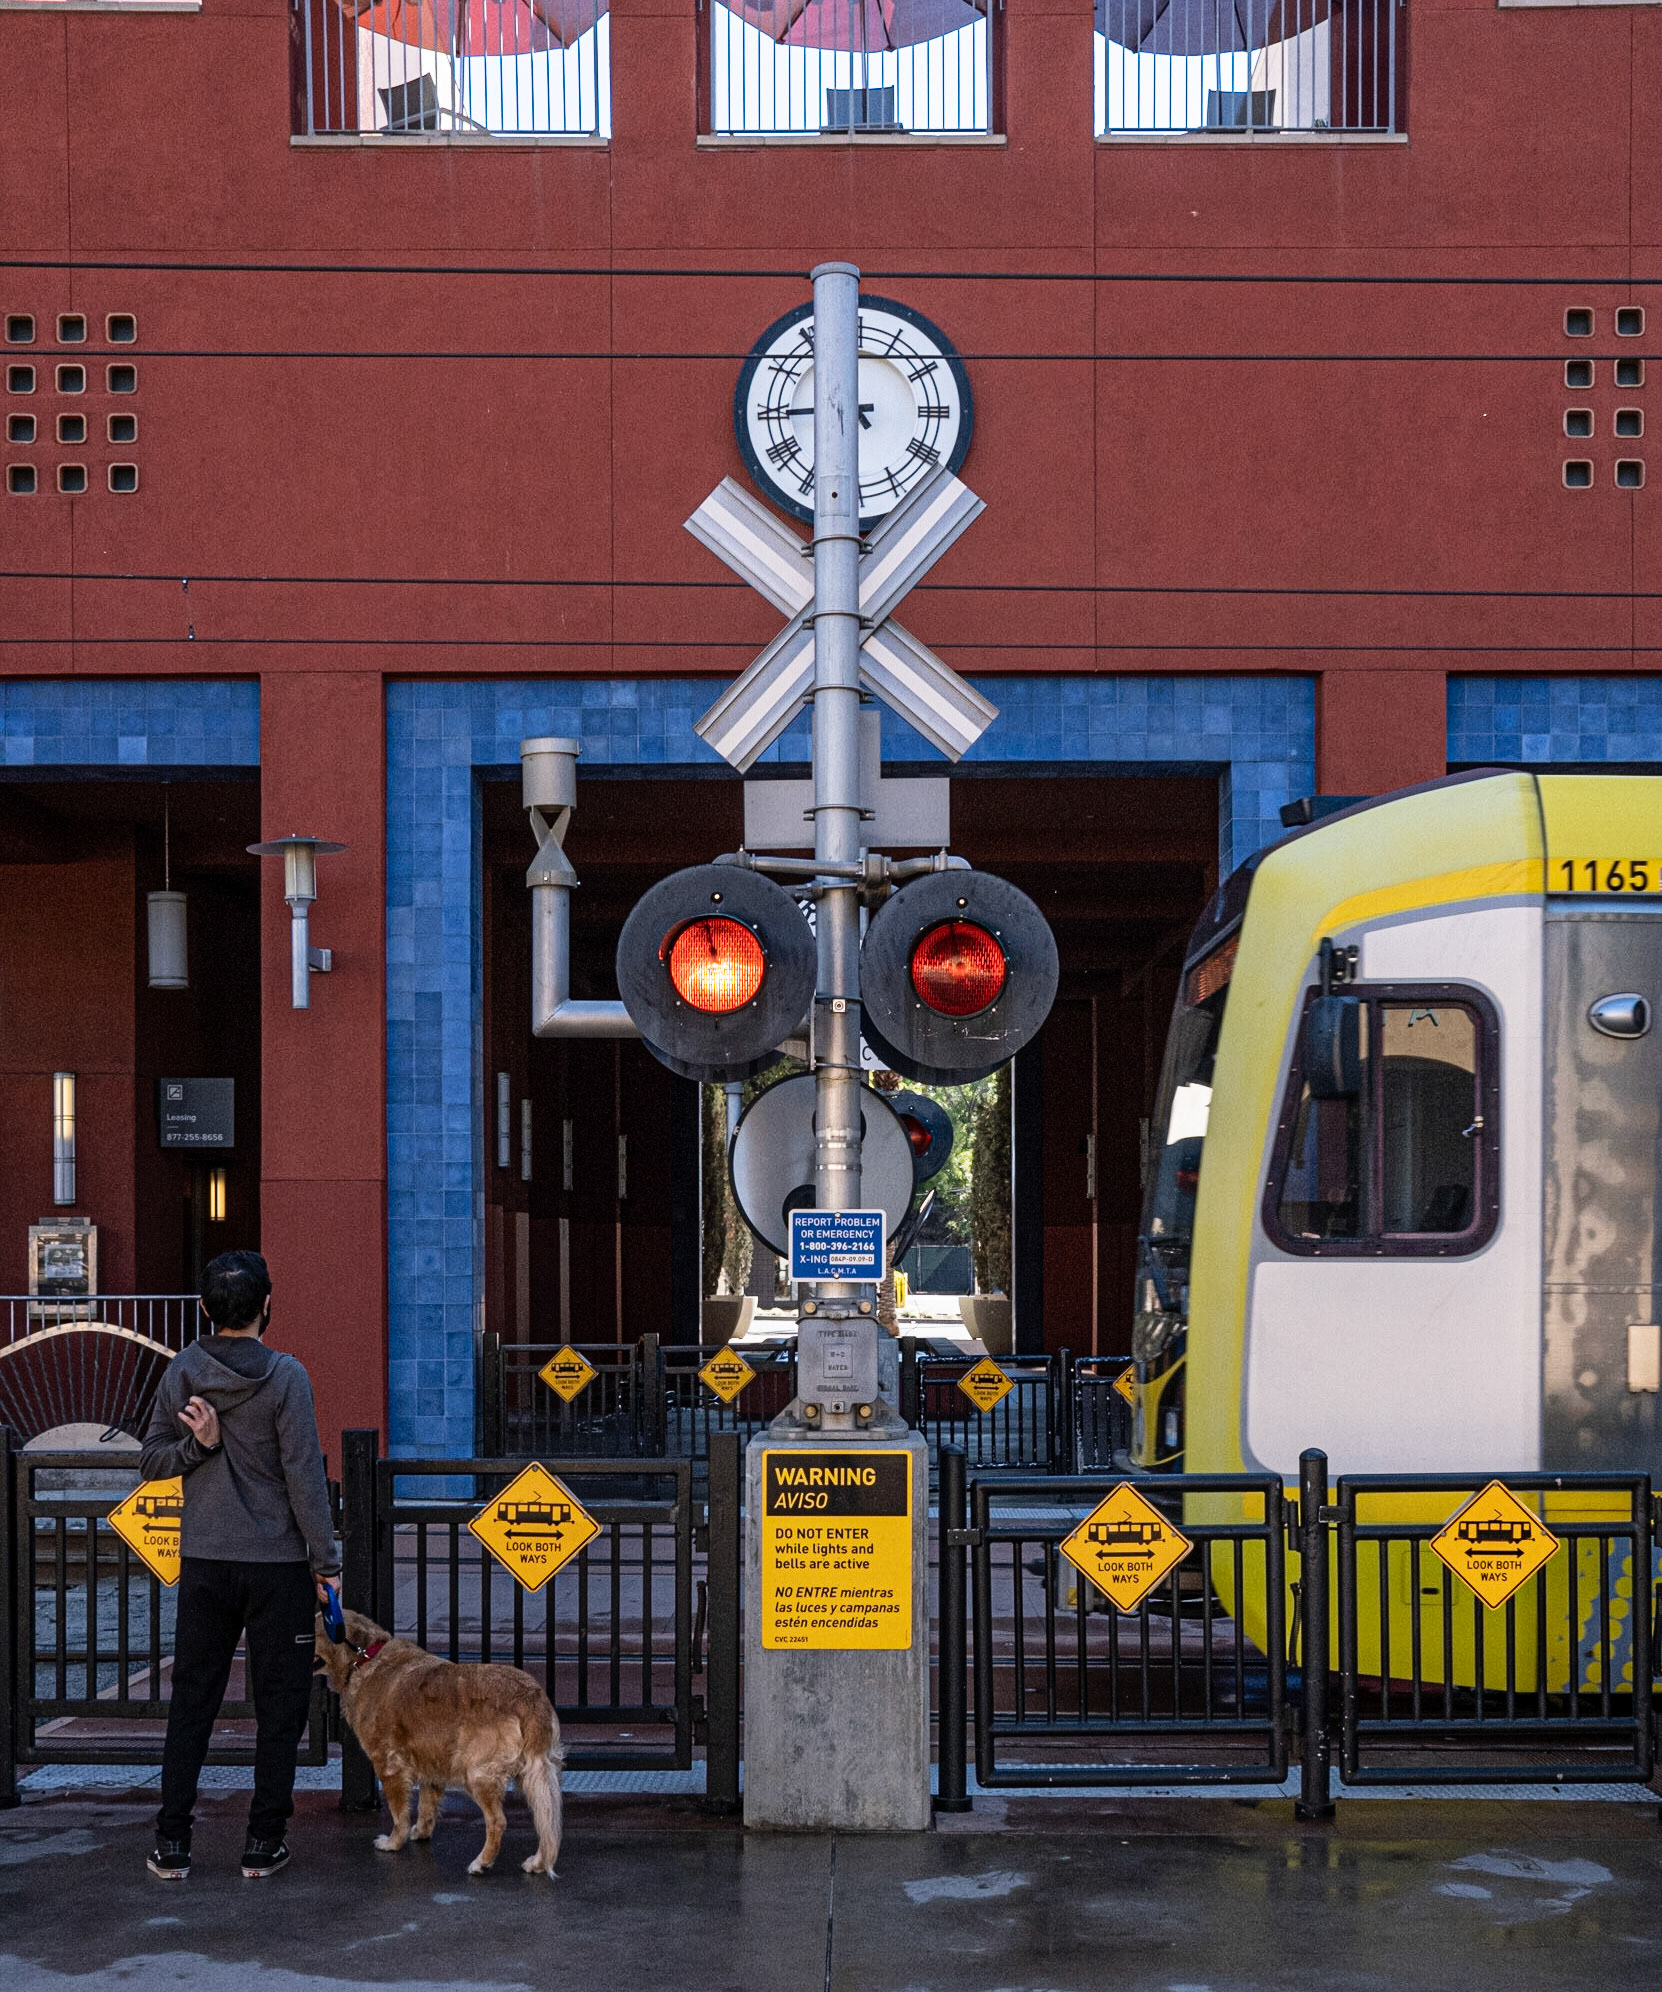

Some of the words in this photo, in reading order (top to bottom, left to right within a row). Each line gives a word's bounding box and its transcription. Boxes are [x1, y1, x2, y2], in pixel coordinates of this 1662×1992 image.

[1561, 860, 1648, 892] 1165
[166, 1113, 197, 1123] Leasing
[795, 1217, 832, 1227] REPORT
[834, 1217, 880, 1227] PROBLEM
[801, 1229, 814, 1238] OR
[816, 1229, 874, 1238] EMERGENCY
[800, 1242, 875, 1251] 1-800-396-2166
[799, 1254, 828, 1264] X-ING
[817, 1267, 857, 1275] L.A.CM.T.A
[775, 1467, 877, 1486] WARNING
[774, 1492, 829, 1509] AVISO
[775, 1528, 793, 1539] DO
[797, 1528, 823, 1539] NOT
[826, 1528, 869, 1539] ENTER
[144, 1536, 170, 1546] LOOK
[506, 1542, 533, 1551] LOOK
[535, 1542, 561, 1552] BOTH
[775, 1543, 809, 1554] while
[813, 1543, 847, 1557] lights
[851, 1543, 874, 1554] and
[520, 1554, 547, 1564] WAYS
[775, 1558, 806, 1569] bells
[809, 1560, 830, 1569] are
[833, 1558, 870, 1569] active
[1098, 1562, 1125, 1572] LOOK
[1127, 1562, 1153, 1572] BOTH
[1466, 1560, 1493, 1570] LOOK
[1496, 1560, 1522, 1570] BOTH
[1112, 1574, 1140, 1584] WAYS
[1480, 1572, 1508, 1582] WAYS
[775, 1587, 793, 1598] NO
[796, 1587, 838, 1598] ENTRE
[840, 1587, 894, 1598] mientras
[775, 1602, 793, 1613] las
[796, 1602, 828, 1613] luces
[830, 1604, 837, 1615] y
[840, 1604, 900, 1615] campanas
[775, 1616, 808, 1628] estén
[811, 1617, 879, 1628] encendidas
